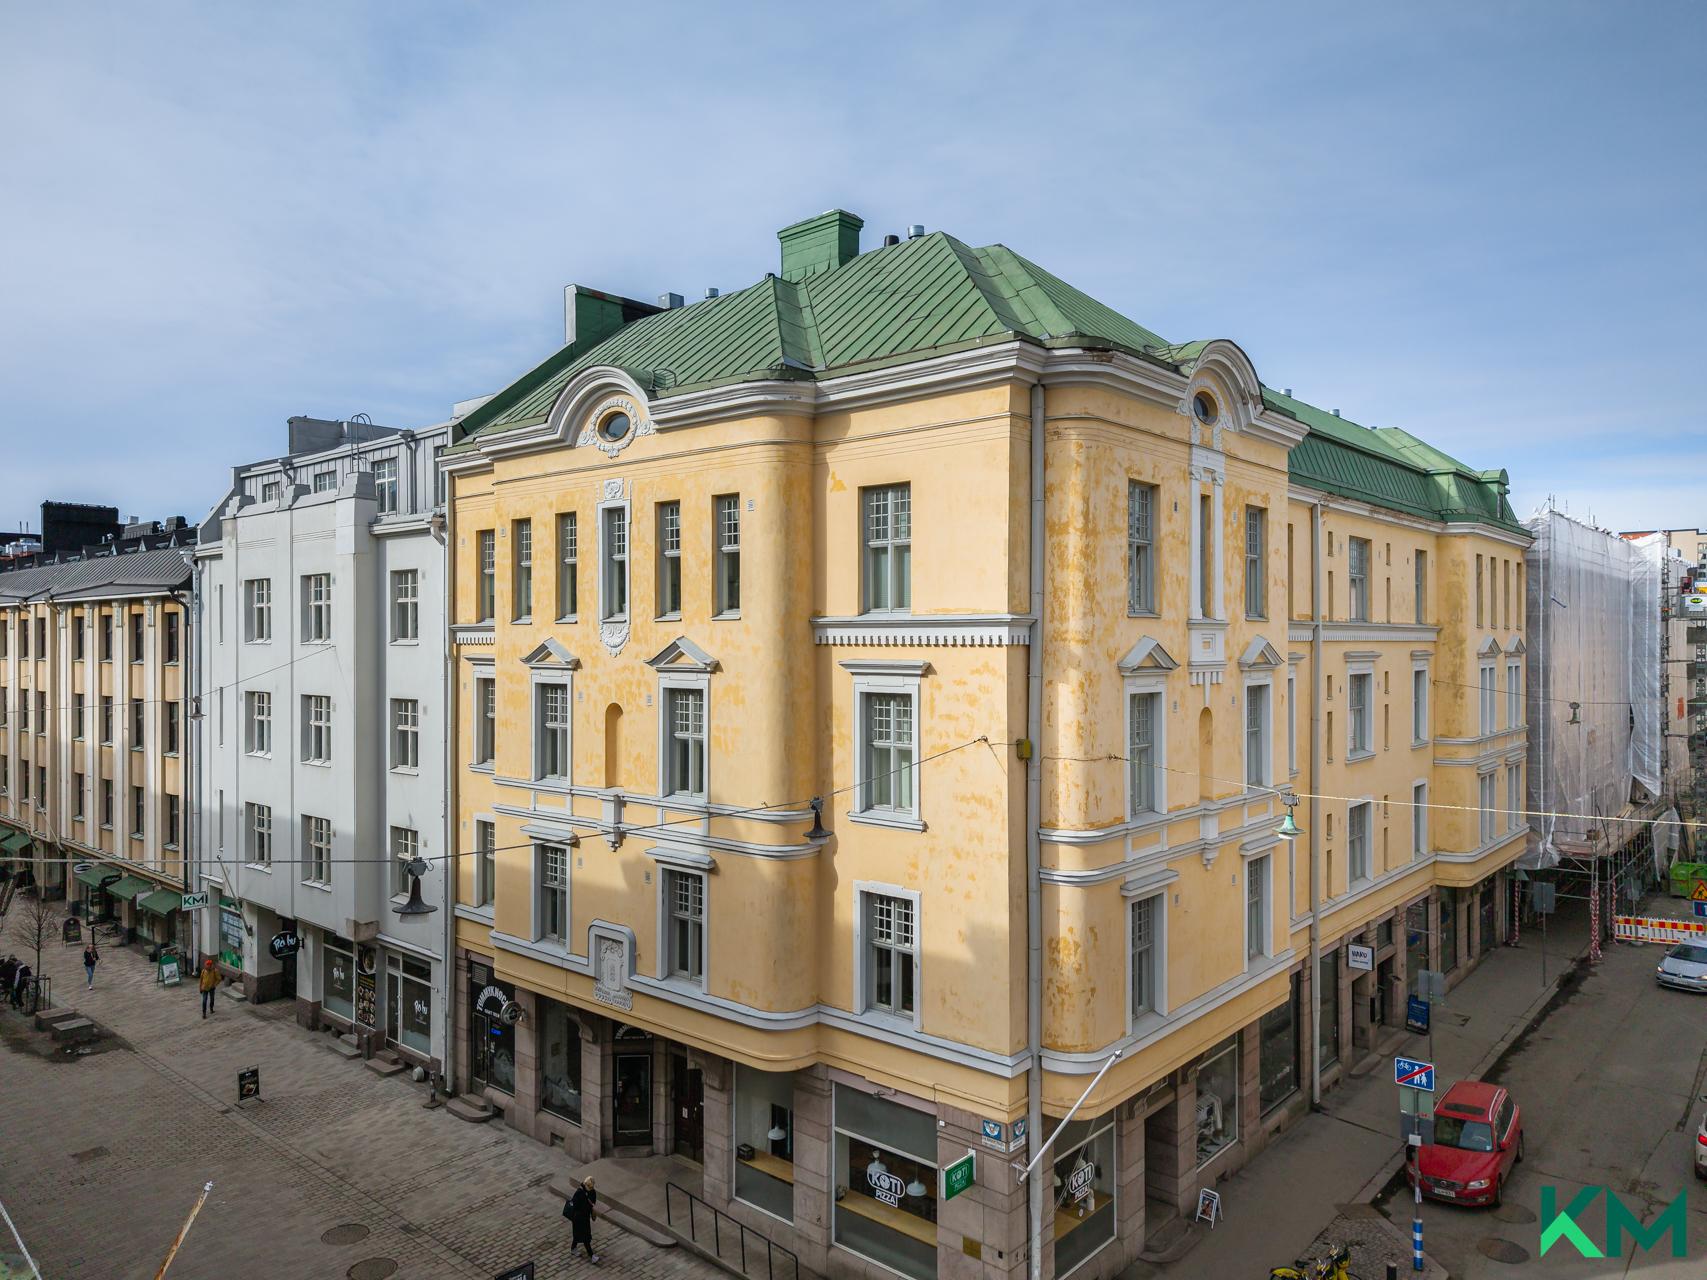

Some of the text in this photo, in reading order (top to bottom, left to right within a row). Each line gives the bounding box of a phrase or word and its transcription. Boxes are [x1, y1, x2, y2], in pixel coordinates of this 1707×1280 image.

[183, 894, 205, 906] KM
[476, 985, 509, 1011] TOMMYKNOC
[871, 1171, 901, 1195] KOTI
[951, 1166, 968, 1181] KOTI
[1071, 1165, 1092, 1191] KOTI
[875, 1189, 896, 1205] PIZZA
